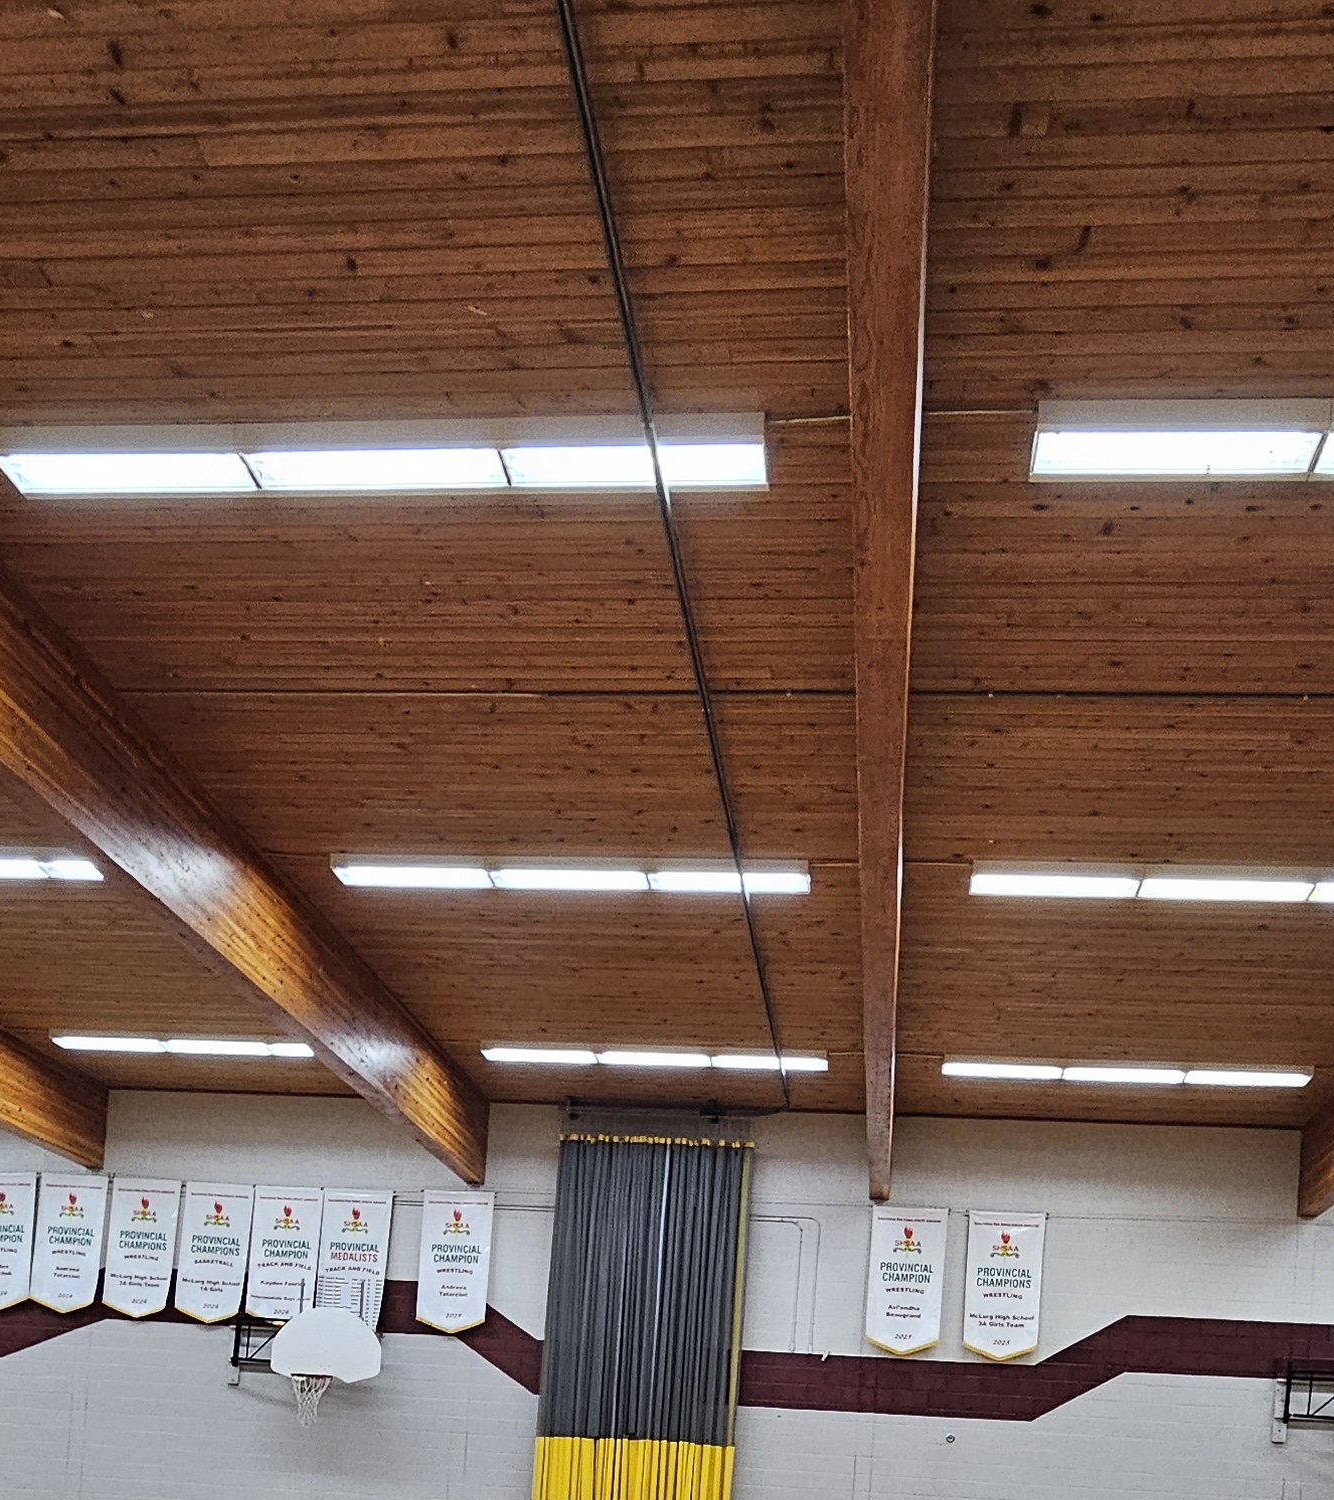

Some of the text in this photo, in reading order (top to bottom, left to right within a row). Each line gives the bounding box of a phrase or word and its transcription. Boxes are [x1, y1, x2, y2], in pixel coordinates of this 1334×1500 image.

[47, 1226, 95, 1237] PROVINCIAL
[120, 1230, 167, 1241] PROVINCIAL
[49, 1235, 92, 1246] CHAMPION
[119, 1240, 167, 1251] CHAMPIONS
[192, 1234, 241, 1247] PROVINCIAL
[262, 1239, 311, 1250] PROVINCIAL
[894, 1240, 922, 1248] SHSAA
[191, 1245, 240, 1256] CHAMPIONS
[330, 1242, 380, 1253] PROVINCIAL
[431, 1243, 482, 1254] PROVINCIAL
[264, 1249, 309, 1259] CHAMPION
[331, 1251, 378, 1263] MEDALISTS
[433, 1254, 479, 1264] CHAMPION
[295, 1262, 311, 1270] FIELD
[362, 1267, 380, 1276] FIELD
[880, 1262, 934, 1274] PROVINCIAL
[882, 1272, 931, 1284] CHAMPION
[977, 1267, 1031, 1279] PROVINCIAL
[976, 1277, 1031, 1289] CHAMPIONS
[886, 1287, 925, 1295] WRESTLING
